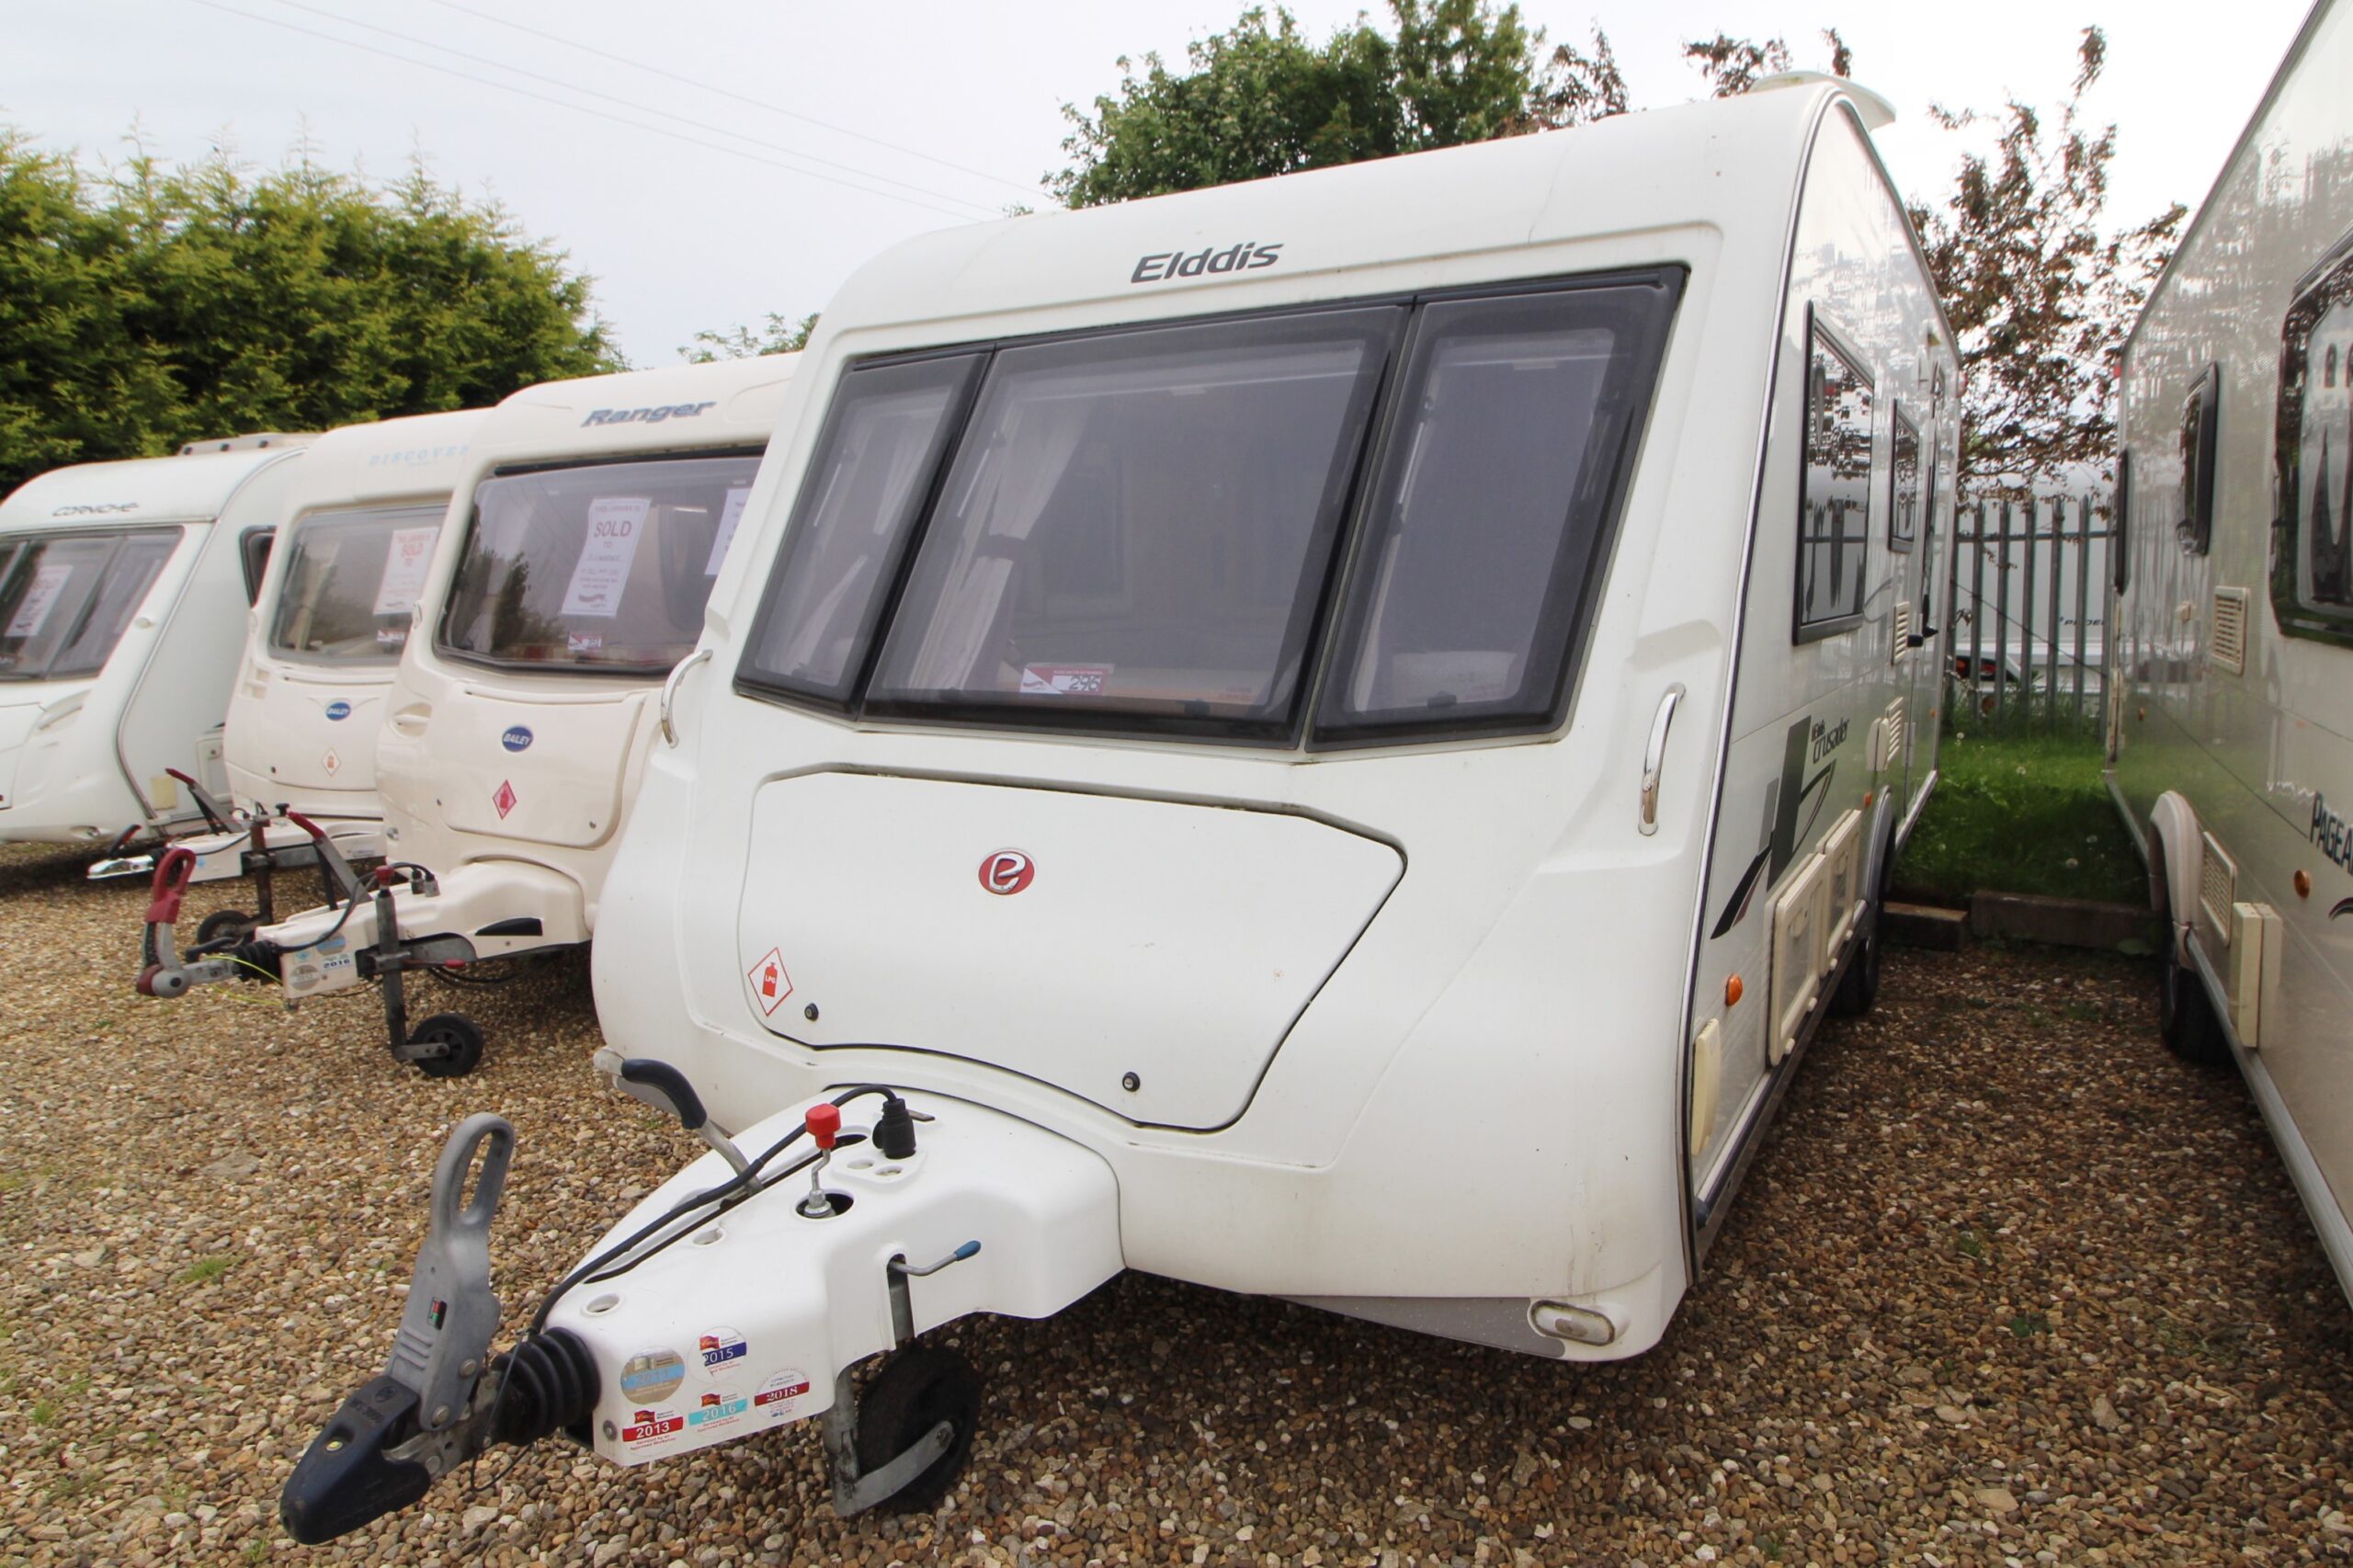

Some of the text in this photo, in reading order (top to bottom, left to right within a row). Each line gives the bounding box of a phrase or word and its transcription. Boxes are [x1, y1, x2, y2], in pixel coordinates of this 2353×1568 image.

[1131, 242, 1284, 284] Elddis
[581, 402, 717, 427] Ranger
[594, 520, 632, 538] SOLD
[1069, 675, 1101, 691] 296
[504, 733, 530, 745] BAILEY
[2310, 790, 2353, 877] PAGEA
[324, 959, 350, 969] 2016
[702, 1347, 733, 1365] 2015
[767, 1386, 798, 1402] 2018
[702, 1403, 736, 1421] 2016
[636, 1422, 670, 1438] 2013
